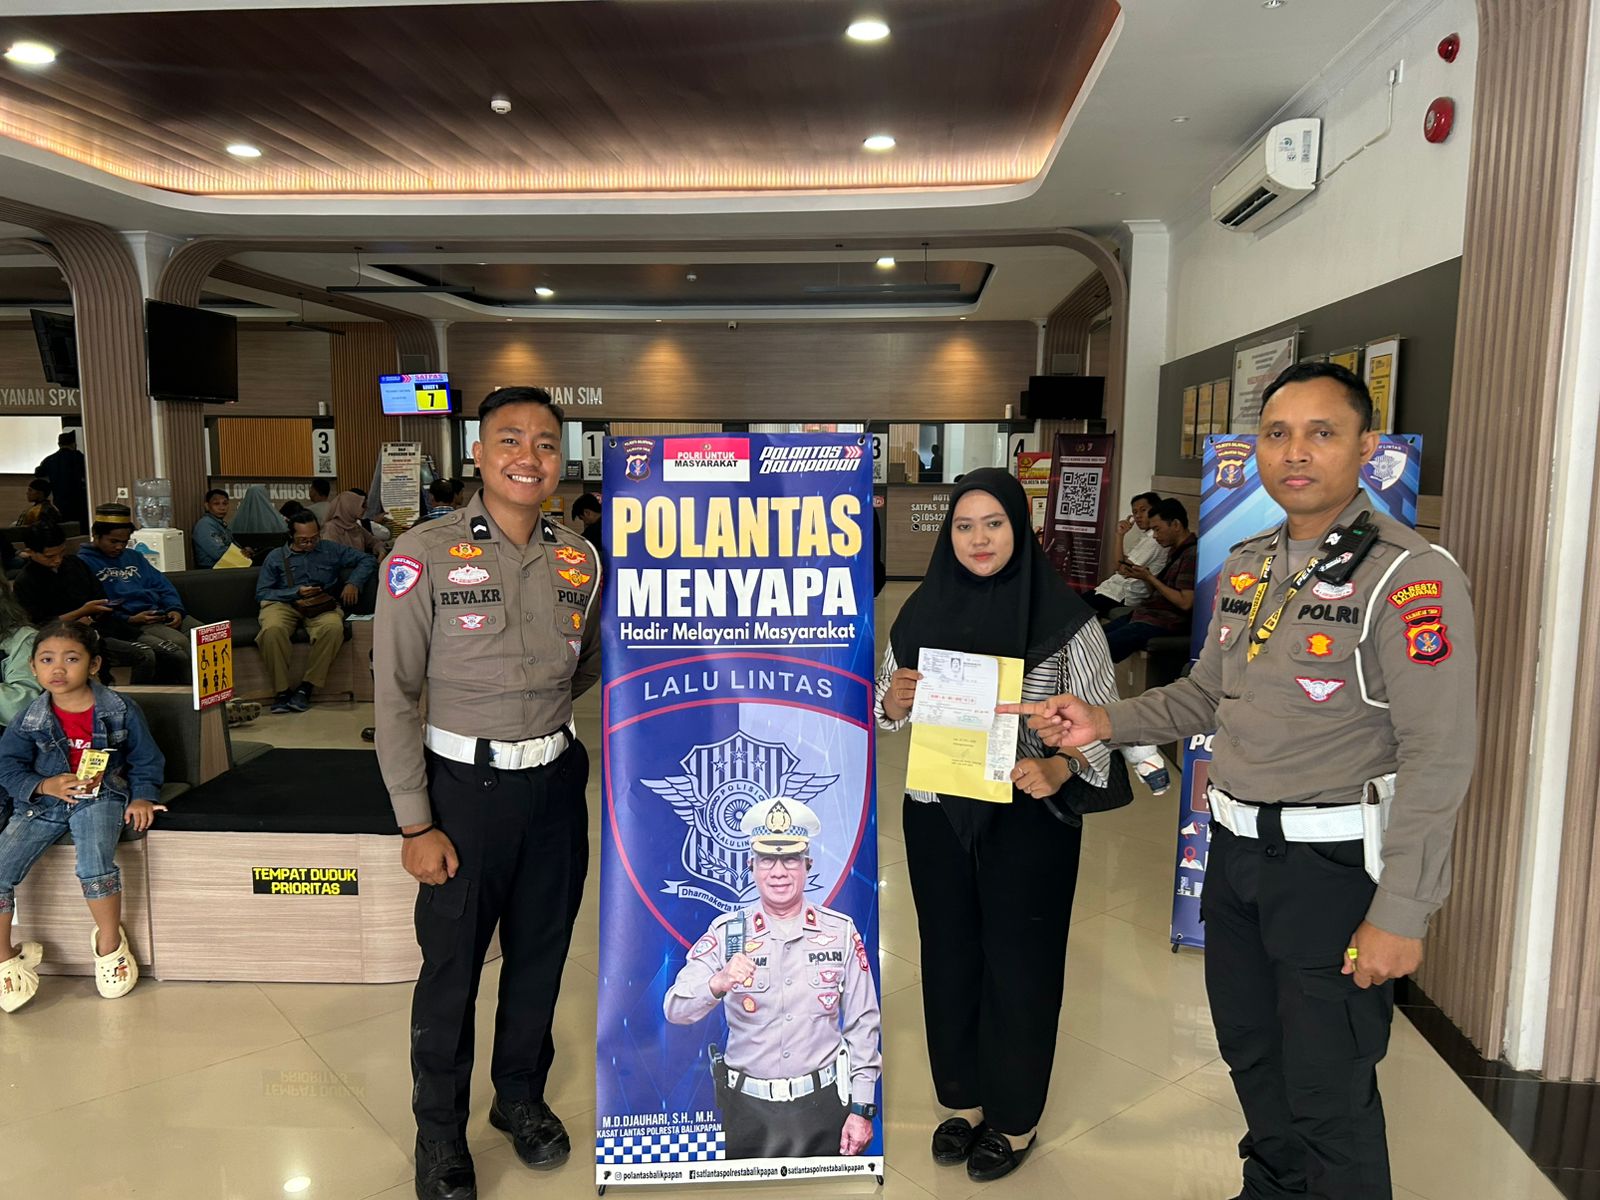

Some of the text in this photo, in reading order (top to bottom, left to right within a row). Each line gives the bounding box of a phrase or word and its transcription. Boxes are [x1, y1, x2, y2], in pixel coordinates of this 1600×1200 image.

[0, 388, 80, 406] YANAN SPK
[428, 393, 434, 407] 7
[578, 386, 602, 405] SIM
[318, 432, 330, 454] 3
[587, 434, 595, 456] 1
[872, 436, 882, 459] 3
[1013, 438, 1024, 457] 4
[678, 452, 734, 460] POLRI UNTUK
[759, 446, 843, 461] POLANTAS
[270, 483, 312, 500] KHUSU
[612, 494, 862, 558] POLANTAS
[440, 588, 501, 606] REVA.KR
[617, 567, 858, 618] MENYAPA
[1392, 582, 1438, 600] POLRESTA
[1298, 604, 1359, 624] POLRI
[620, 621, 855, 644] Hadir Melayani Masyarakat
[644, 670, 833, 700] LALU LINTAS
[68, 738, 91, 749] ARA
[721, 784, 758, 795] POLISI
[716, 832, 734, 847] LALU
[253, 868, 357, 881] TEMPAT DUDUK
[271, 882, 340, 894] PRIORITAS
[682, 888, 732, 912] Dharmakerta
[809, 951, 842, 963] POLRI
[672, 1112, 693, 1124] S.H.,
[696, 1111, 716, 1122] M.H.
[597, 1124, 721, 1138] KASAT LANTAS POLRESTA BALIKPAPAN
